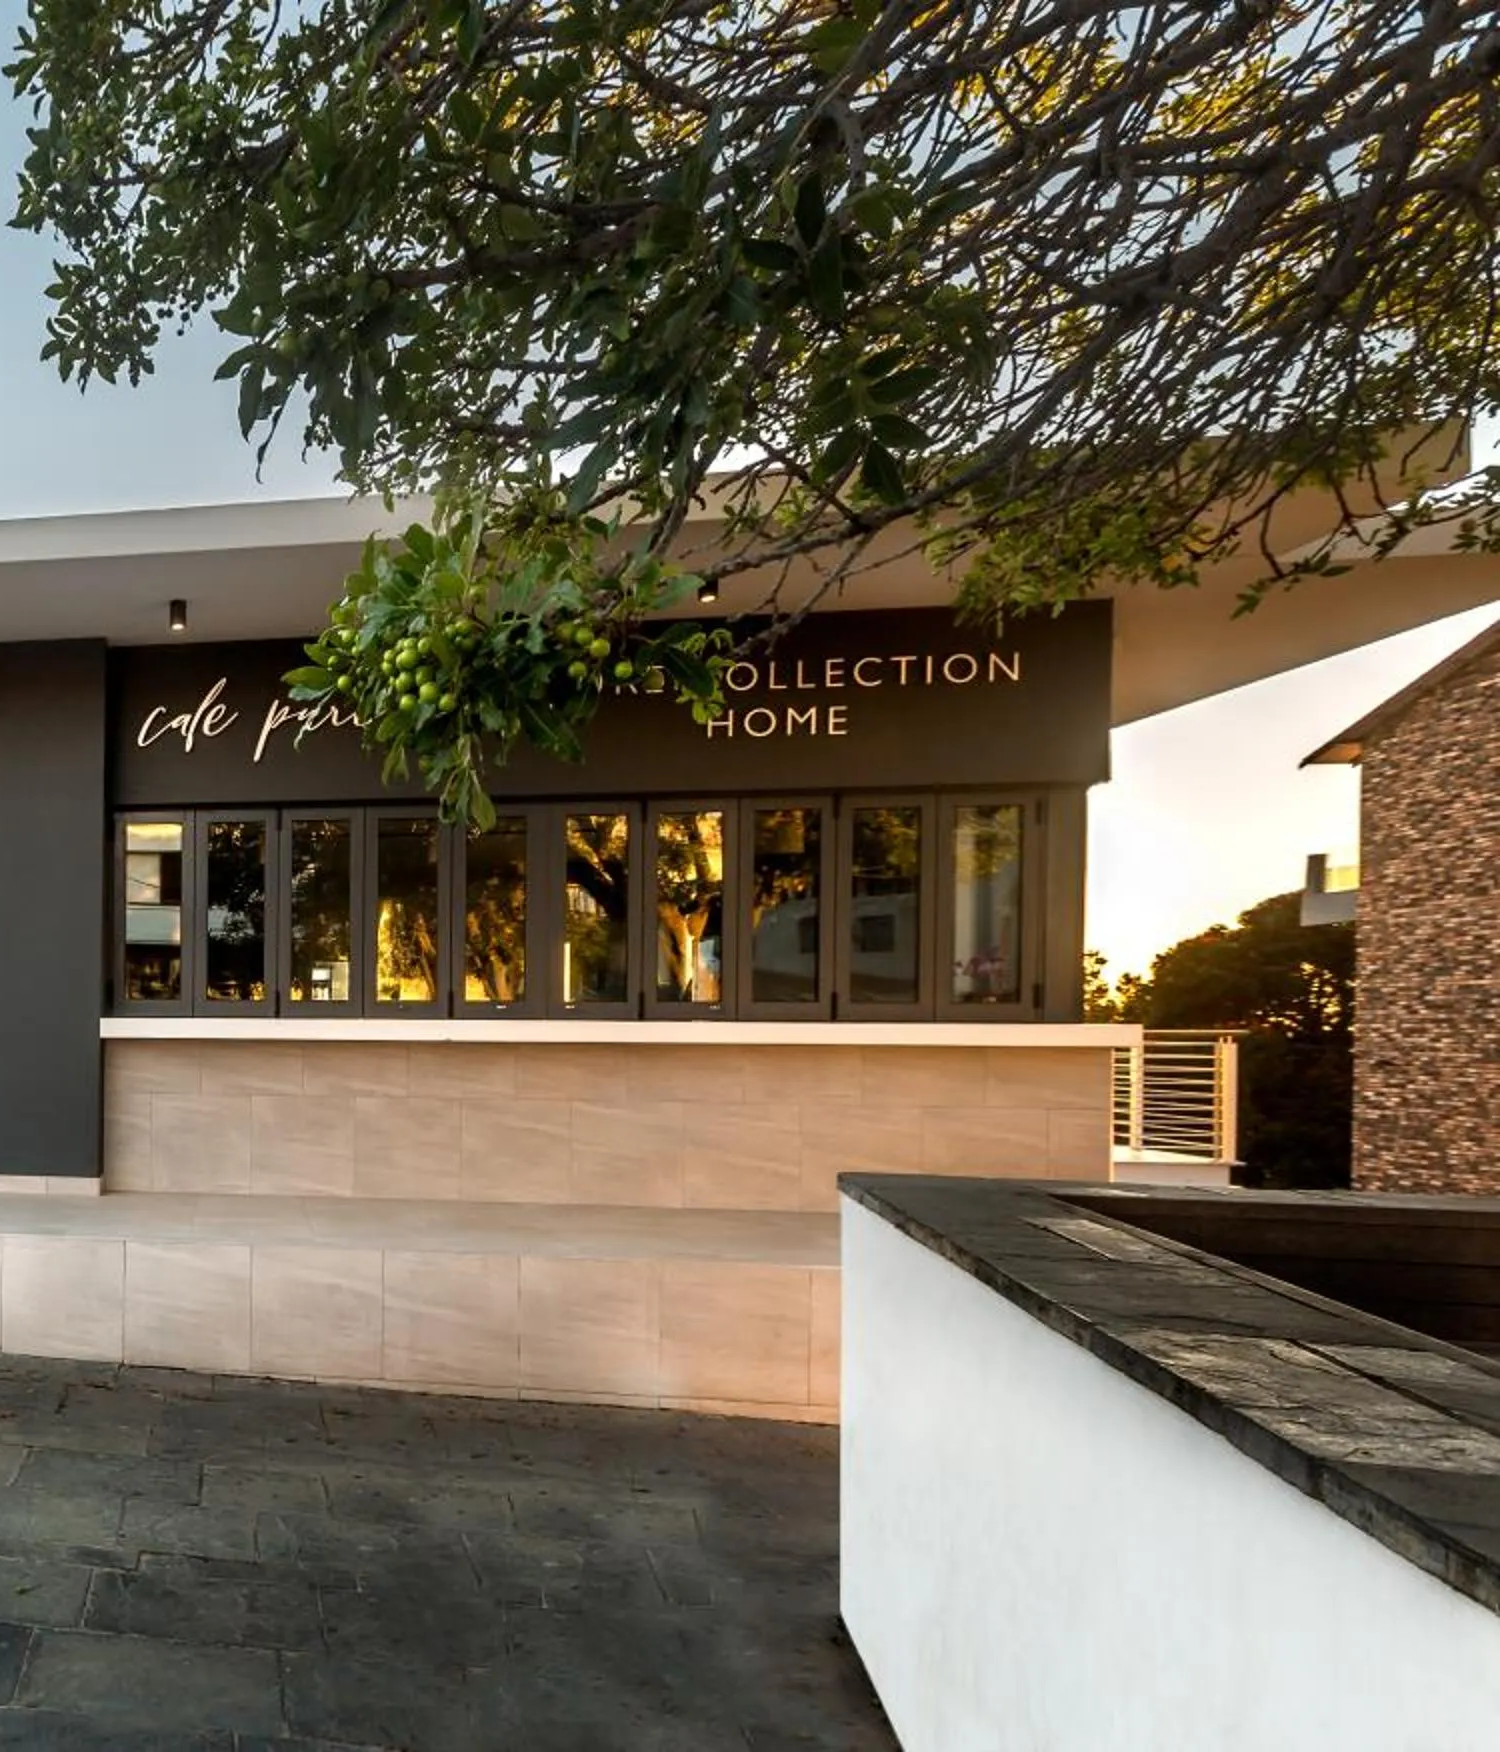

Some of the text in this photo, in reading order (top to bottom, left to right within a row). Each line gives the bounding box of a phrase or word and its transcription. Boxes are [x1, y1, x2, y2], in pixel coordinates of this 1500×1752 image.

[725, 652, 1021, 691] OLLECTION
[137, 677, 239, 753] cafe
[707, 705, 848, 739] HOME
